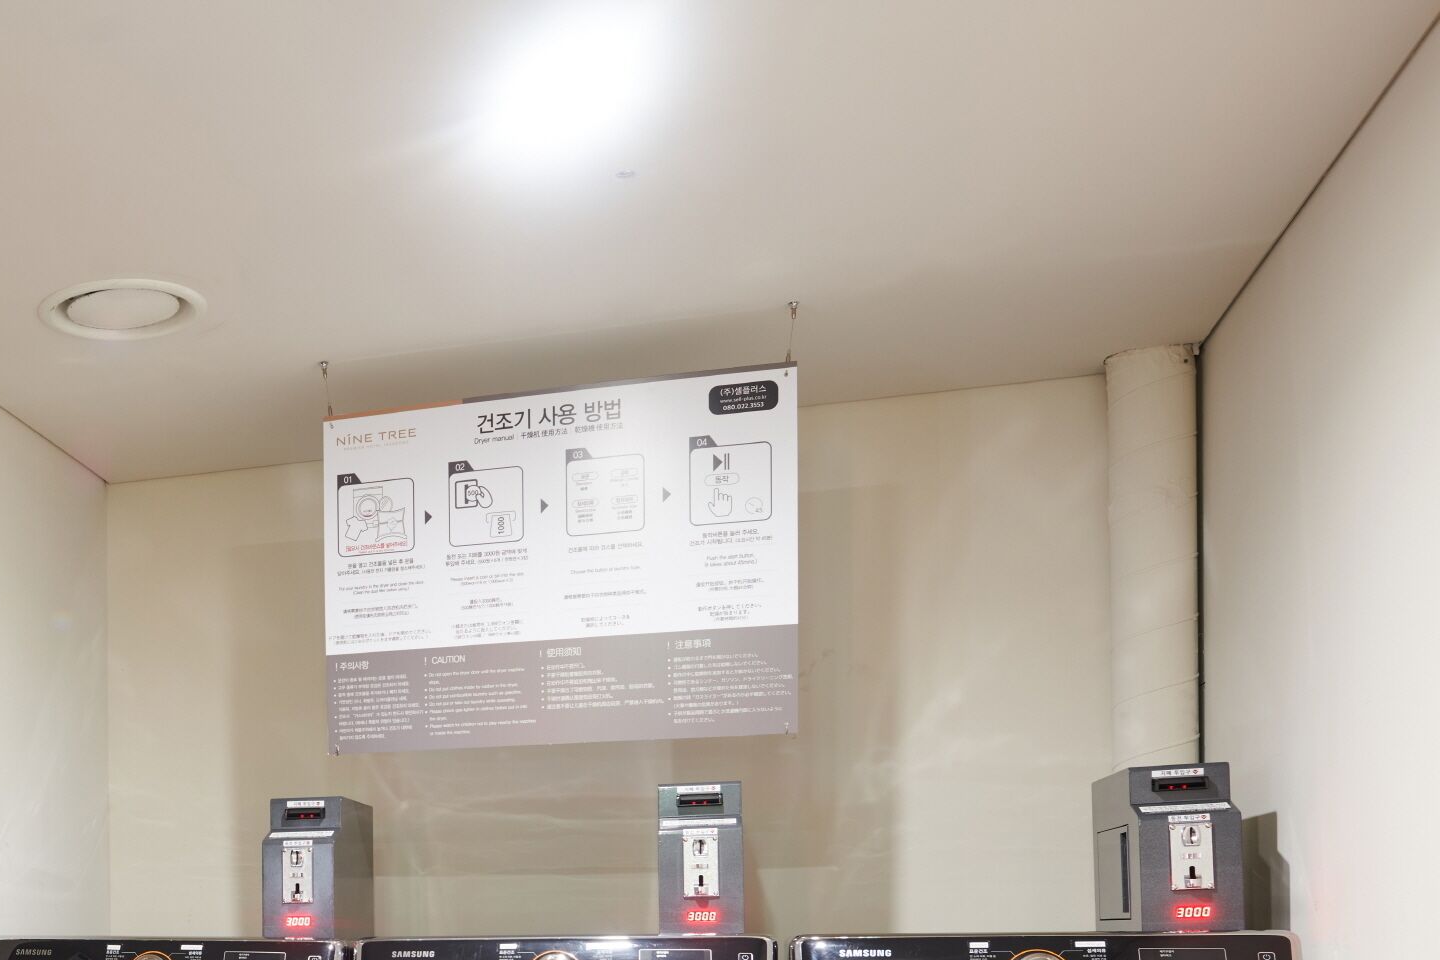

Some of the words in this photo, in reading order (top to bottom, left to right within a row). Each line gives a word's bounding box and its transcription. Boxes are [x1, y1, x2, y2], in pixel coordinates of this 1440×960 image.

[477, 408, 531, 434] 건조기
[538, 404, 577, 426] 사용
[584, 398, 621, 423] 방법
[378, 428, 416, 440] TREE
[474, 437, 490, 445] Dryer
[696, 438, 707, 447] 04
[573, 451, 583, 459] 03
[455, 463, 465, 471] 02
[343, 476, 352, 484] 01
[674, 638, 711, 650] 注意事項
[431, 655, 466, 664] CAUTION
[340, 660, 370, 671] 주의사항
[688, 911, 716, 921] 3000
[1176, 907, 1211, 917] 3000
[286, 917, 310, 926] 3000
[839, 949, 892, 958] SAMSUNG
